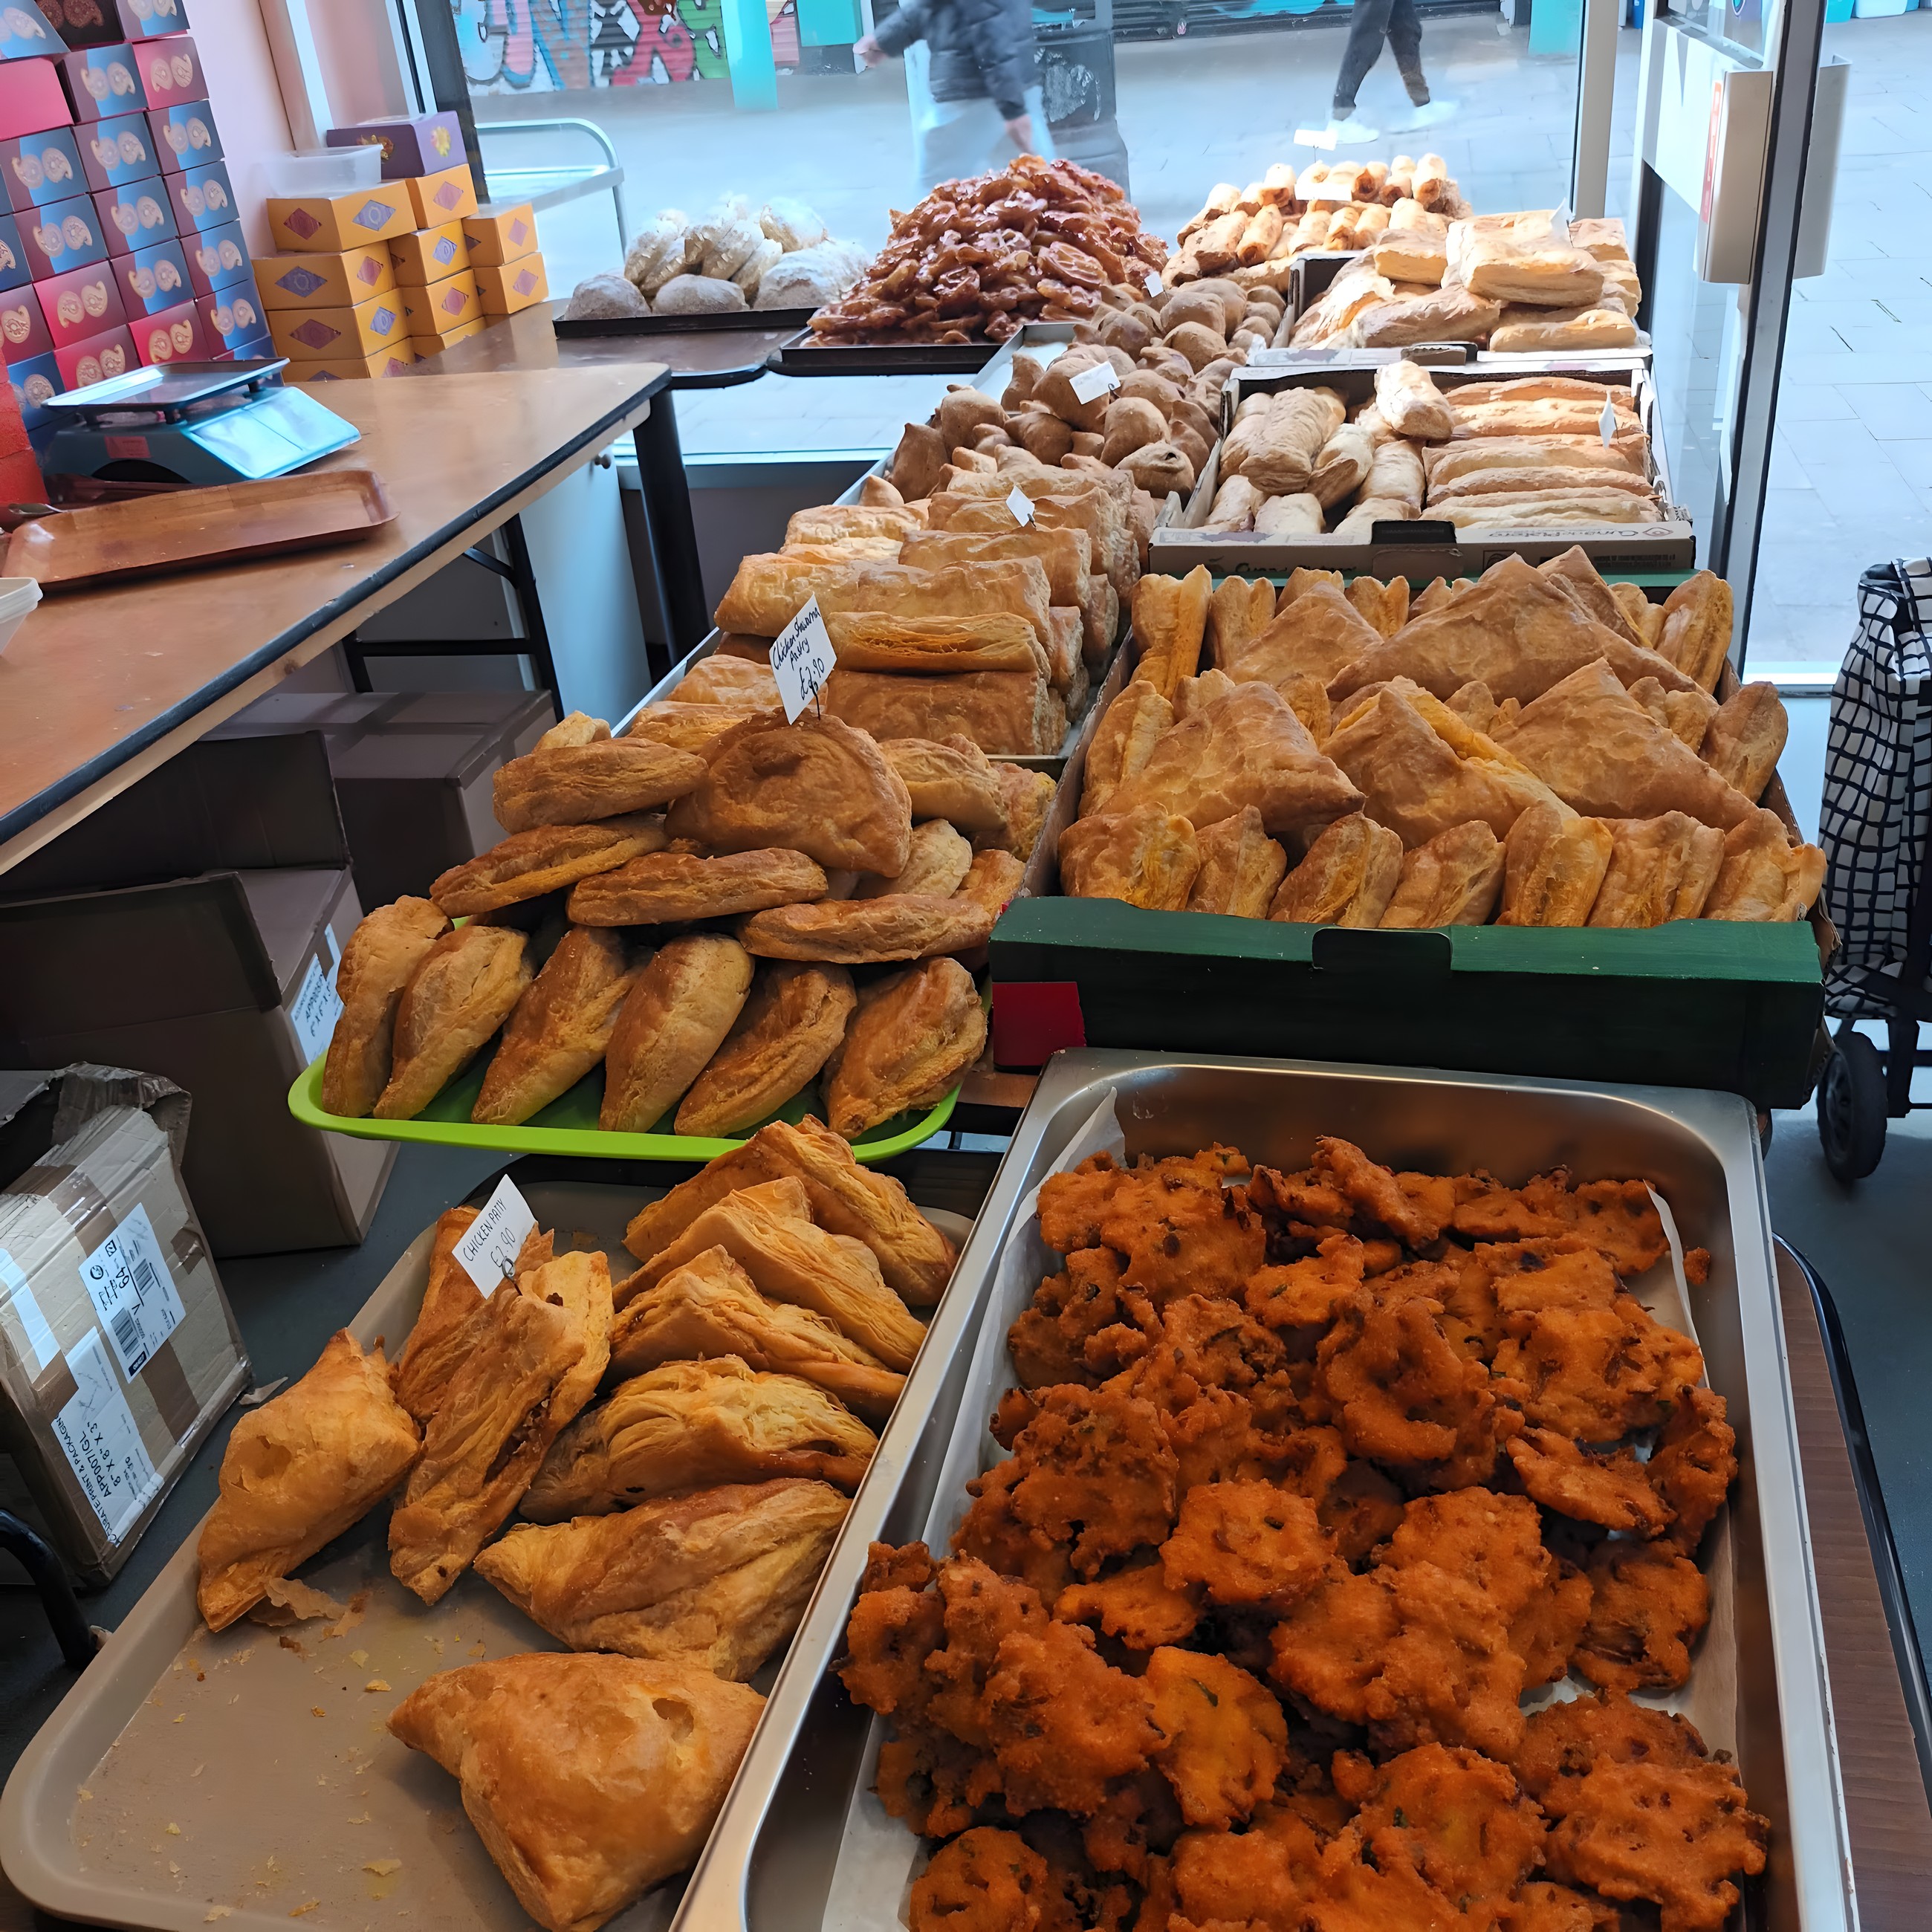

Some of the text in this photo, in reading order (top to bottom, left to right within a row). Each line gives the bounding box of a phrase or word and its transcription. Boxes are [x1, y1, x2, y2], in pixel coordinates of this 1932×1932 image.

[773, 635, 796, 670] Chicken
[463, 1198, 507, 1262] CHICKEN PATTY
[116, 1266, 130, 1289] 64
[94, 1432, 104, 1446] X
[78, 1465, 85, 1474] &
[106, 1459, 115, 1472] X
[81, 1474, 97, 1500] PRINT
